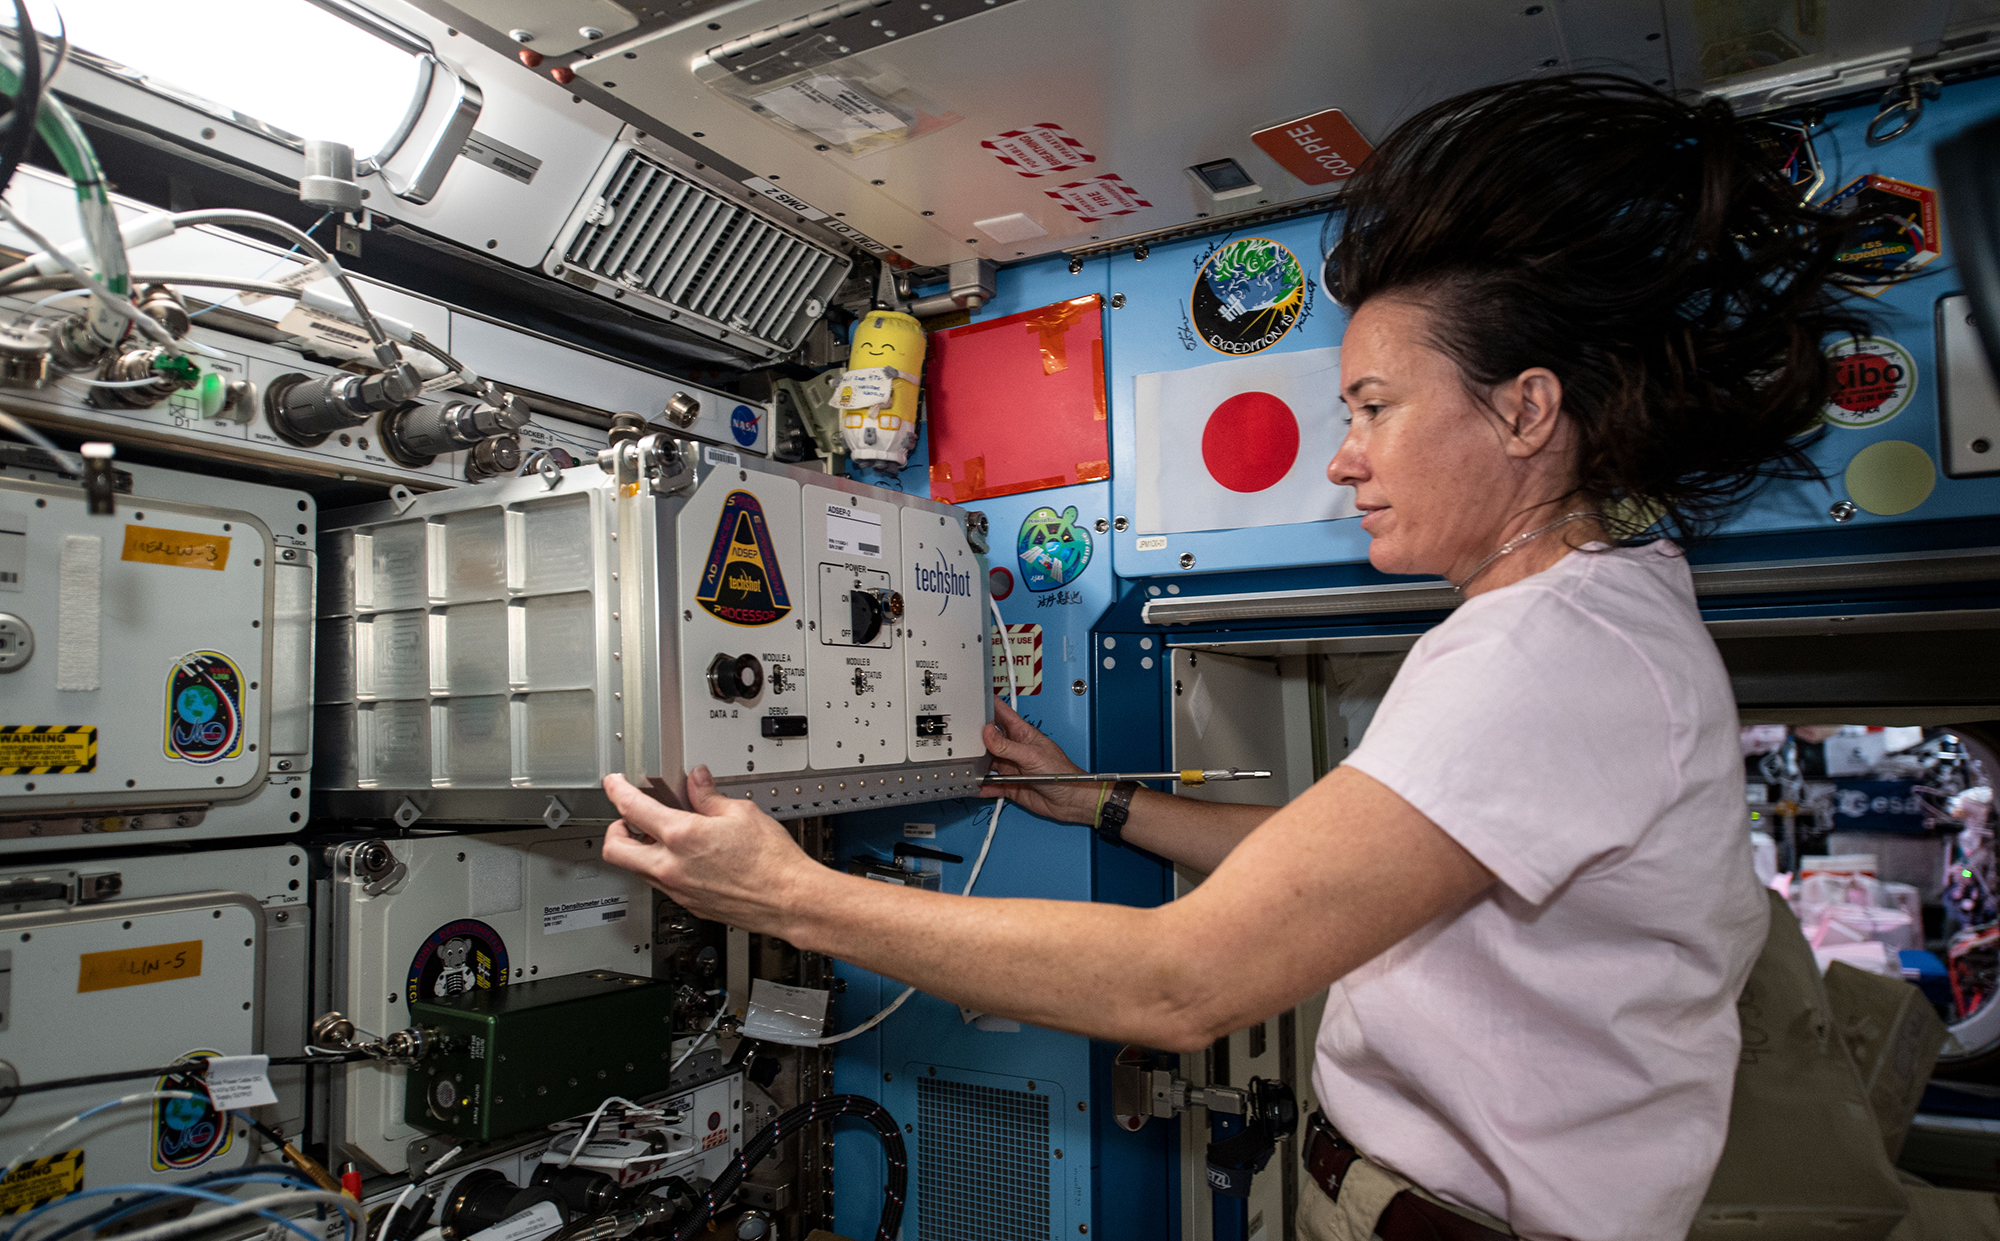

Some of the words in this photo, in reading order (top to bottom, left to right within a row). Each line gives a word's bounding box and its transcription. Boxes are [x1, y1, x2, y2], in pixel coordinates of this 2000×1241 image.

[1286, 124, 1331, 154] PFE
[1018, 135, 1063, 167] BREATHING
[1038, 131, 1078, 161] APPARATUS
[1003, 143, 1041, 169] PORTABLE
[1315, 152, 1355, 176] CO2
[764, 187, 778, 195] 2
[775, 193, 809, 211] DMS
[1068, 192, 1099, 213] PORTABLE
[1086, 190, 1113, 207] FIRE
[1862, 240, 1882, 250] ISS
[1842, 244, 1906, 261] Expedition
[1209, 326, 1284, 354] EXPEDITION
[1280, 314, 1294, 327] 19
[210, 363, 234, 373] POWER
[175, 416, 191, 429] D1
[733, 418, 757, 434] NASA
[255, 432, 278, 442] SUPPLY
[519, 428, 547, 441] LOCKER
[365, 454, 387, 463] RETURN
[727, 496, 761, 512] SPACE
[828, 506, 851, 517] ADSEP-2
[844, 562, 867, 573] POWER
[728, 575, 762, 593] techshot
[914, 561, 971, 597] techshot
[841, 594, 849, 603] ON
[713, 604, 776, 622] PROCESSOR
[841, 629, 851, 638] OFF
[762, 653, 786, 662] MODULE
[787, 654, 791, 662] A
[846, 657, 866, 666] MODULE
[915, 660, 934, 668] MODULE
[784, 668, 805, 677] STATUS
[864, 671, 882, 679] STATUS
[710, 709, 727, 718] DATA
[731, 709, 738, 718] J2
[769, 707, 788, 715] DEBUG
[0, 734, 66, 743] WARNING
[776, 738, 783, 747] J3
[544, 906, 560, 914] Bone
[561, 900, 600, 911] Densitometer
[600, 896, 620, 905] Locker
[414, 940, 436, 969] BONE
[439, 922, 503, 954] DENSITOMETER
